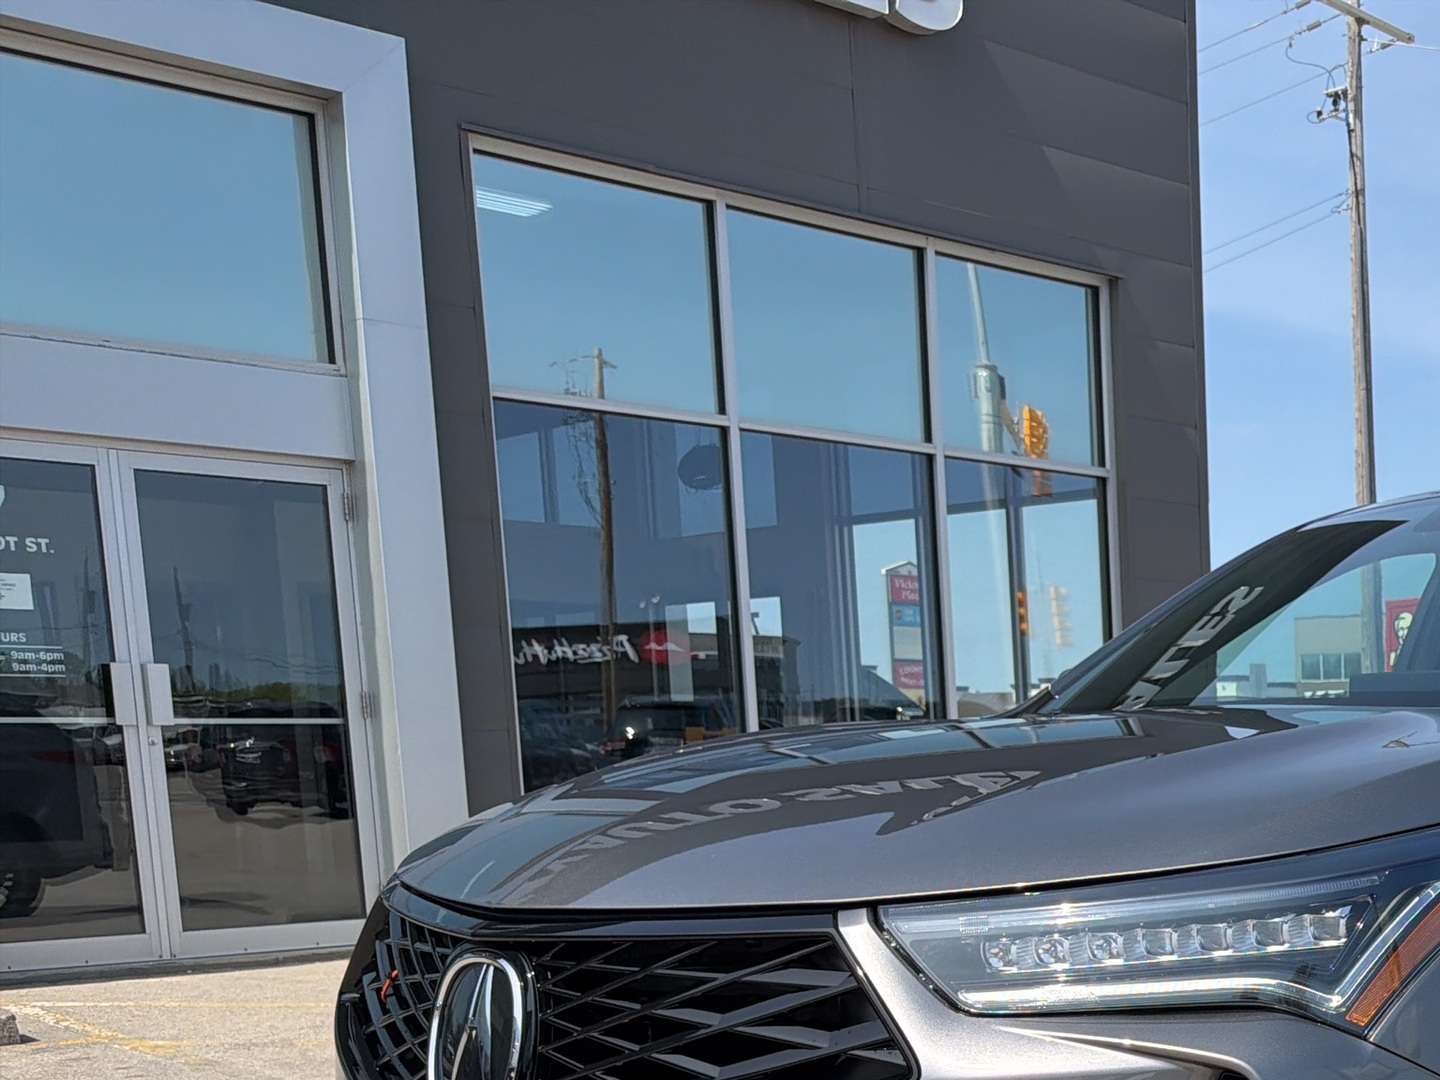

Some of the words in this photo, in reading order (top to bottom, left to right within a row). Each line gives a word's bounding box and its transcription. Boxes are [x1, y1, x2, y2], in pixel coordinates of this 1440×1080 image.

[24, 537, 56, 554] ST.
[0, 631, 27, 643] URS
[10, 650, 65, 661] 9am-6pm
[12, 662, 66, 673] 9am-4pm
